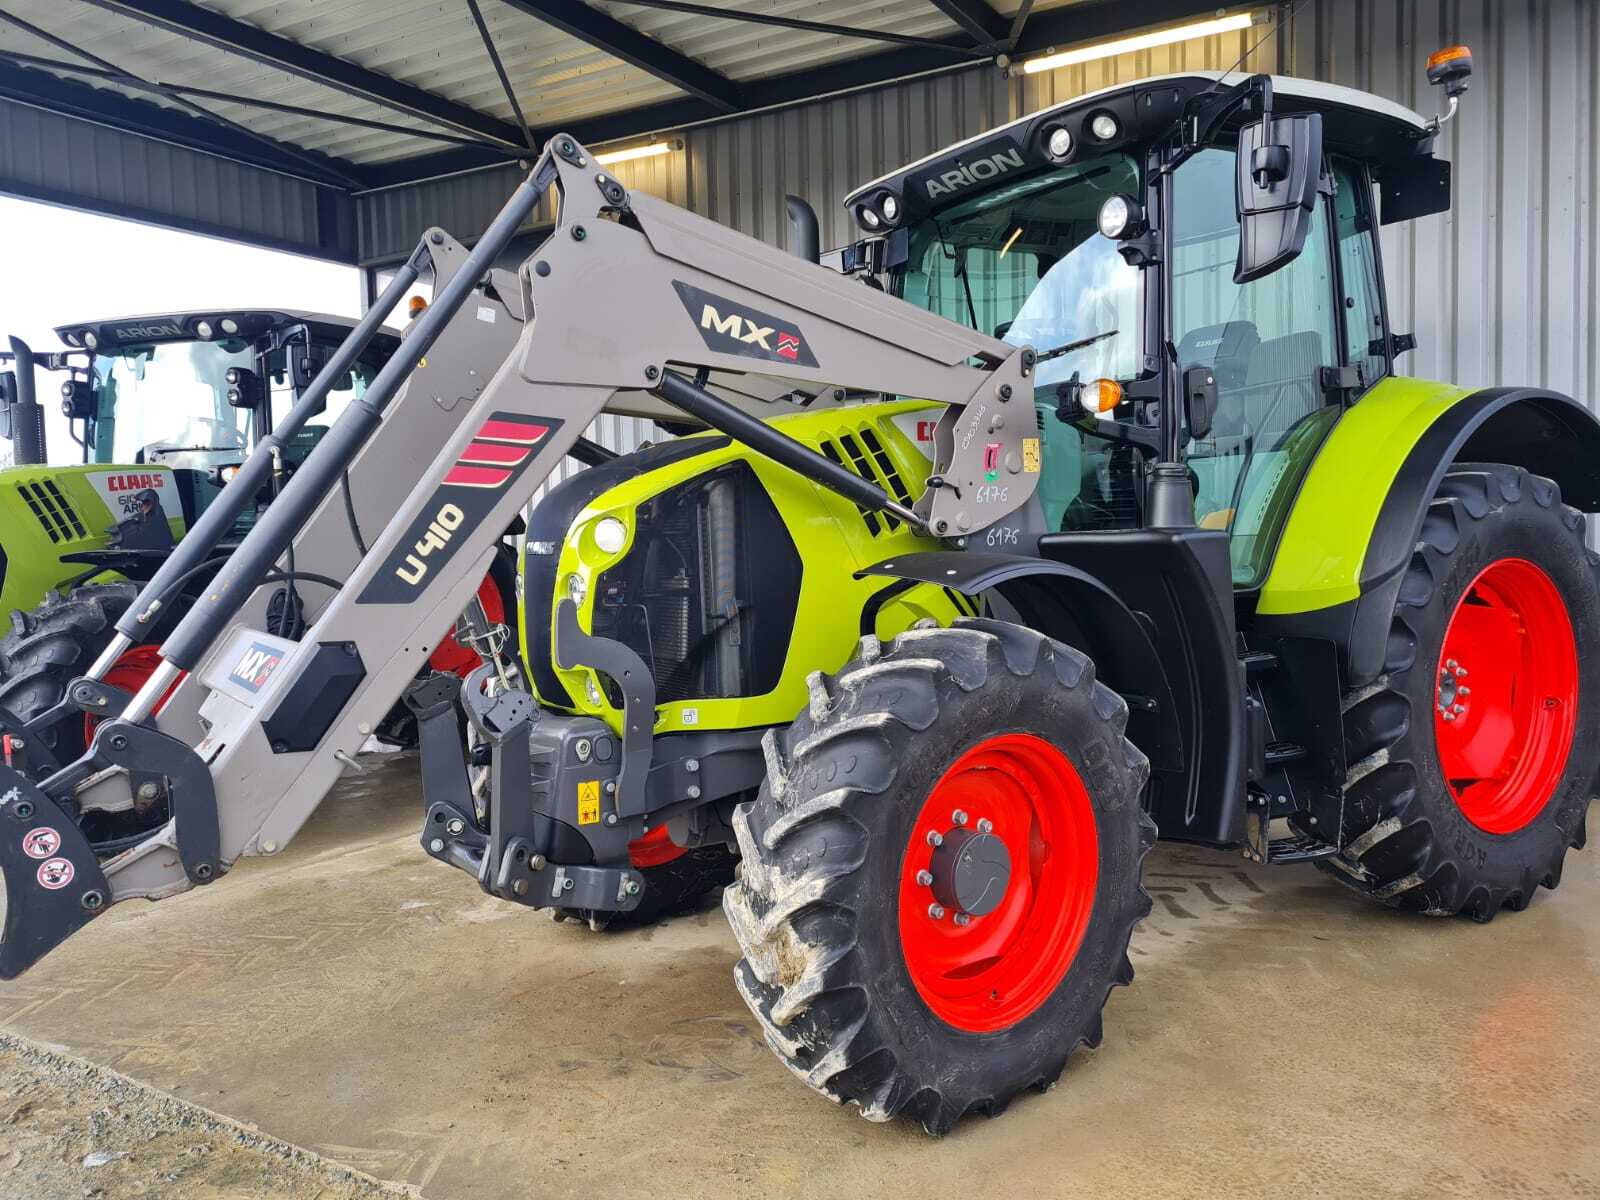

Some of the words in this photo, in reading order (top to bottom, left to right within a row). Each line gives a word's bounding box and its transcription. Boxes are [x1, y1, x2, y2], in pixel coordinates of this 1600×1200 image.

[925, 147, 1025, 199] ARION
[115, 321, 183, 339] ARION
[701, 303, 776, 351] MX
[107, 473, 164, 492] CLAAS
[395, 553, 428, 586] U
[414, 502, 465, 557] 410
[986, 527, 1020, 547] 6176
[232, 646, 273, 683] MX
